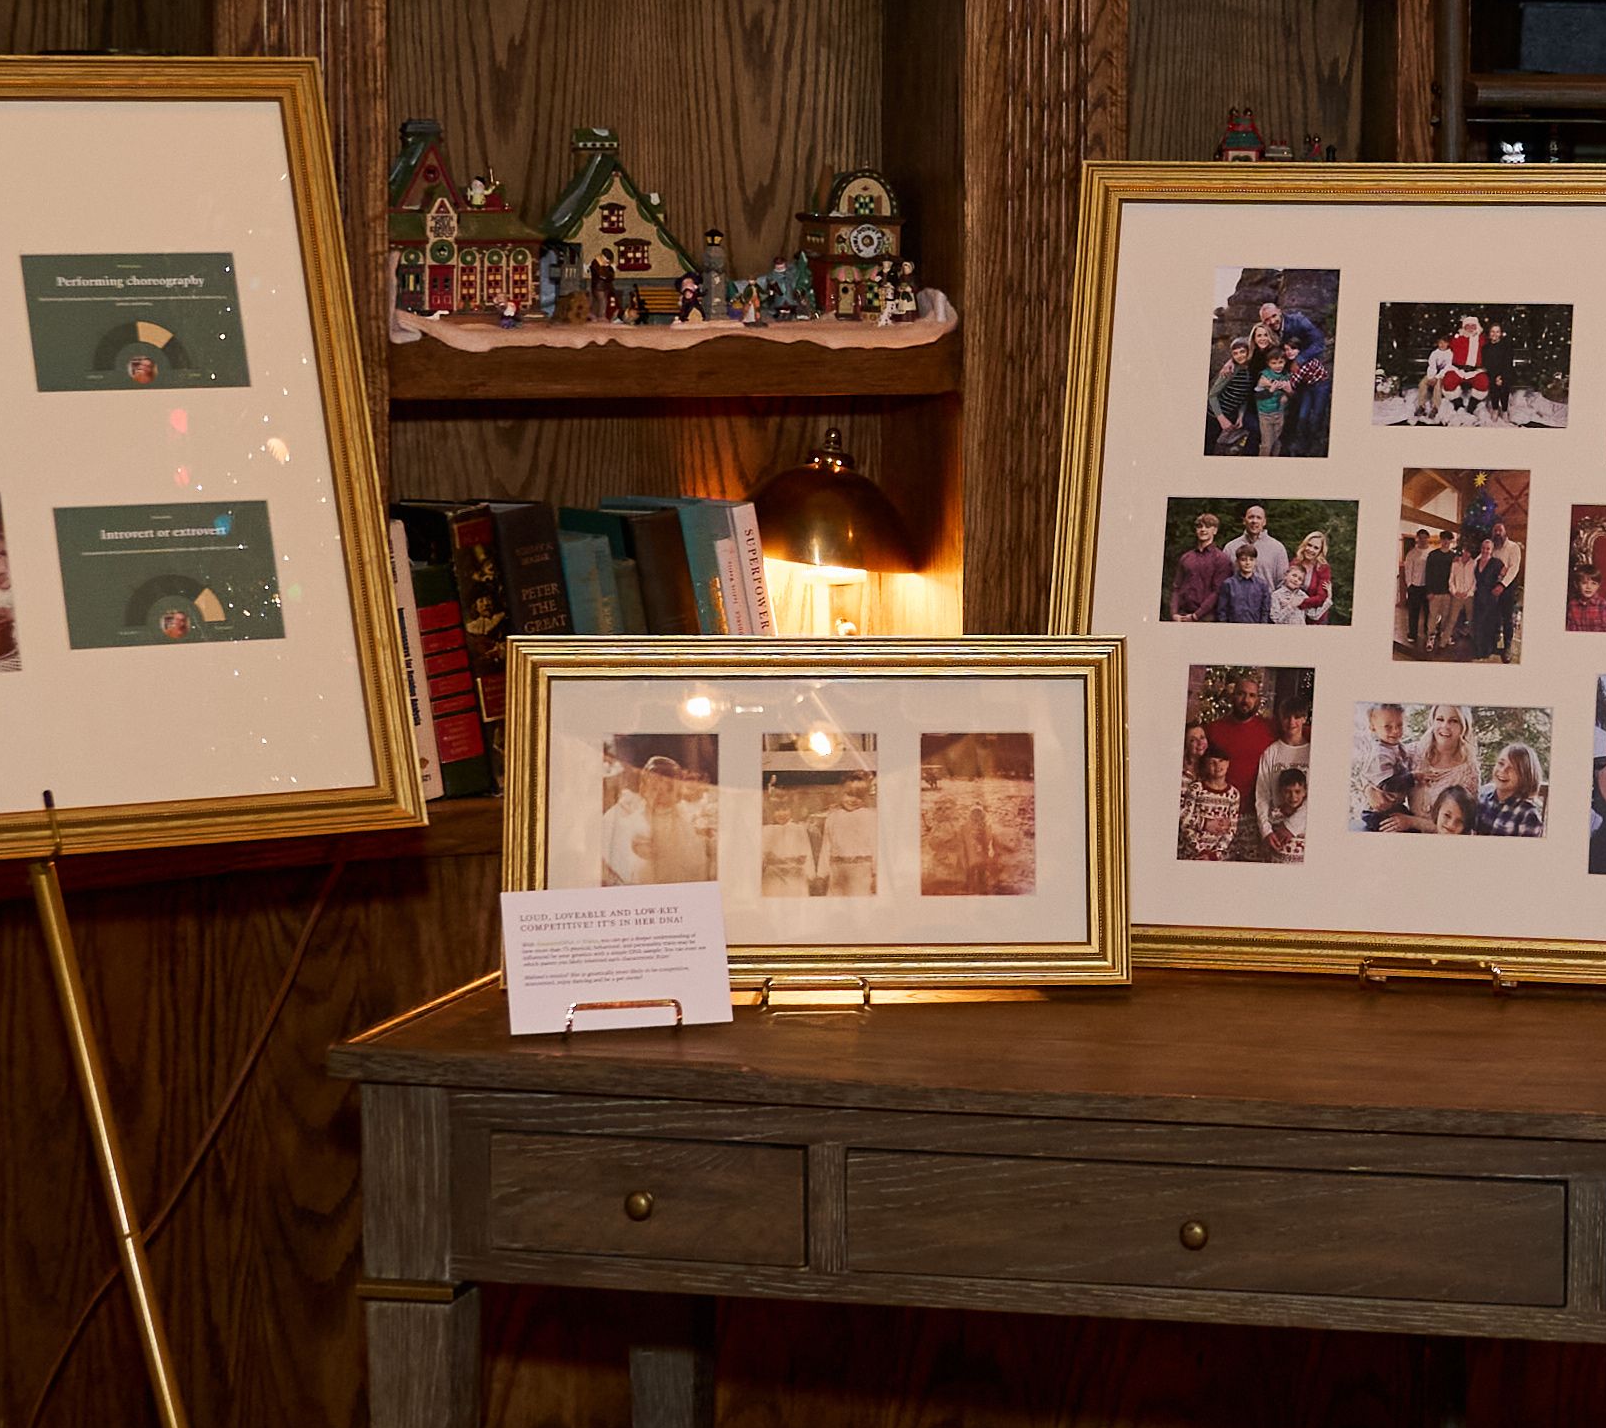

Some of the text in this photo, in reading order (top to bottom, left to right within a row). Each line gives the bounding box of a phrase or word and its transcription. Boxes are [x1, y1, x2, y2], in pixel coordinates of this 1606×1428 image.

[56, 276, 205, 290] Performing choreography
[100, 527, 226, 540] Introvert or extrovert
[744, 529, 770, 630] SUPERPOWER
[522, 583, 559, 600] PETER
[530, 600, 557, 614] THE
[524, 614, 567, 634] GREAT
[520, 914, 551, 922] LOUD,
[555, 910, 606, 920] LOVEABLE
[635, 907, 679, 916] LOW-KEY
[598, 920, 616, 928] IT'S
[659, 916, 683, 924] DNA!
